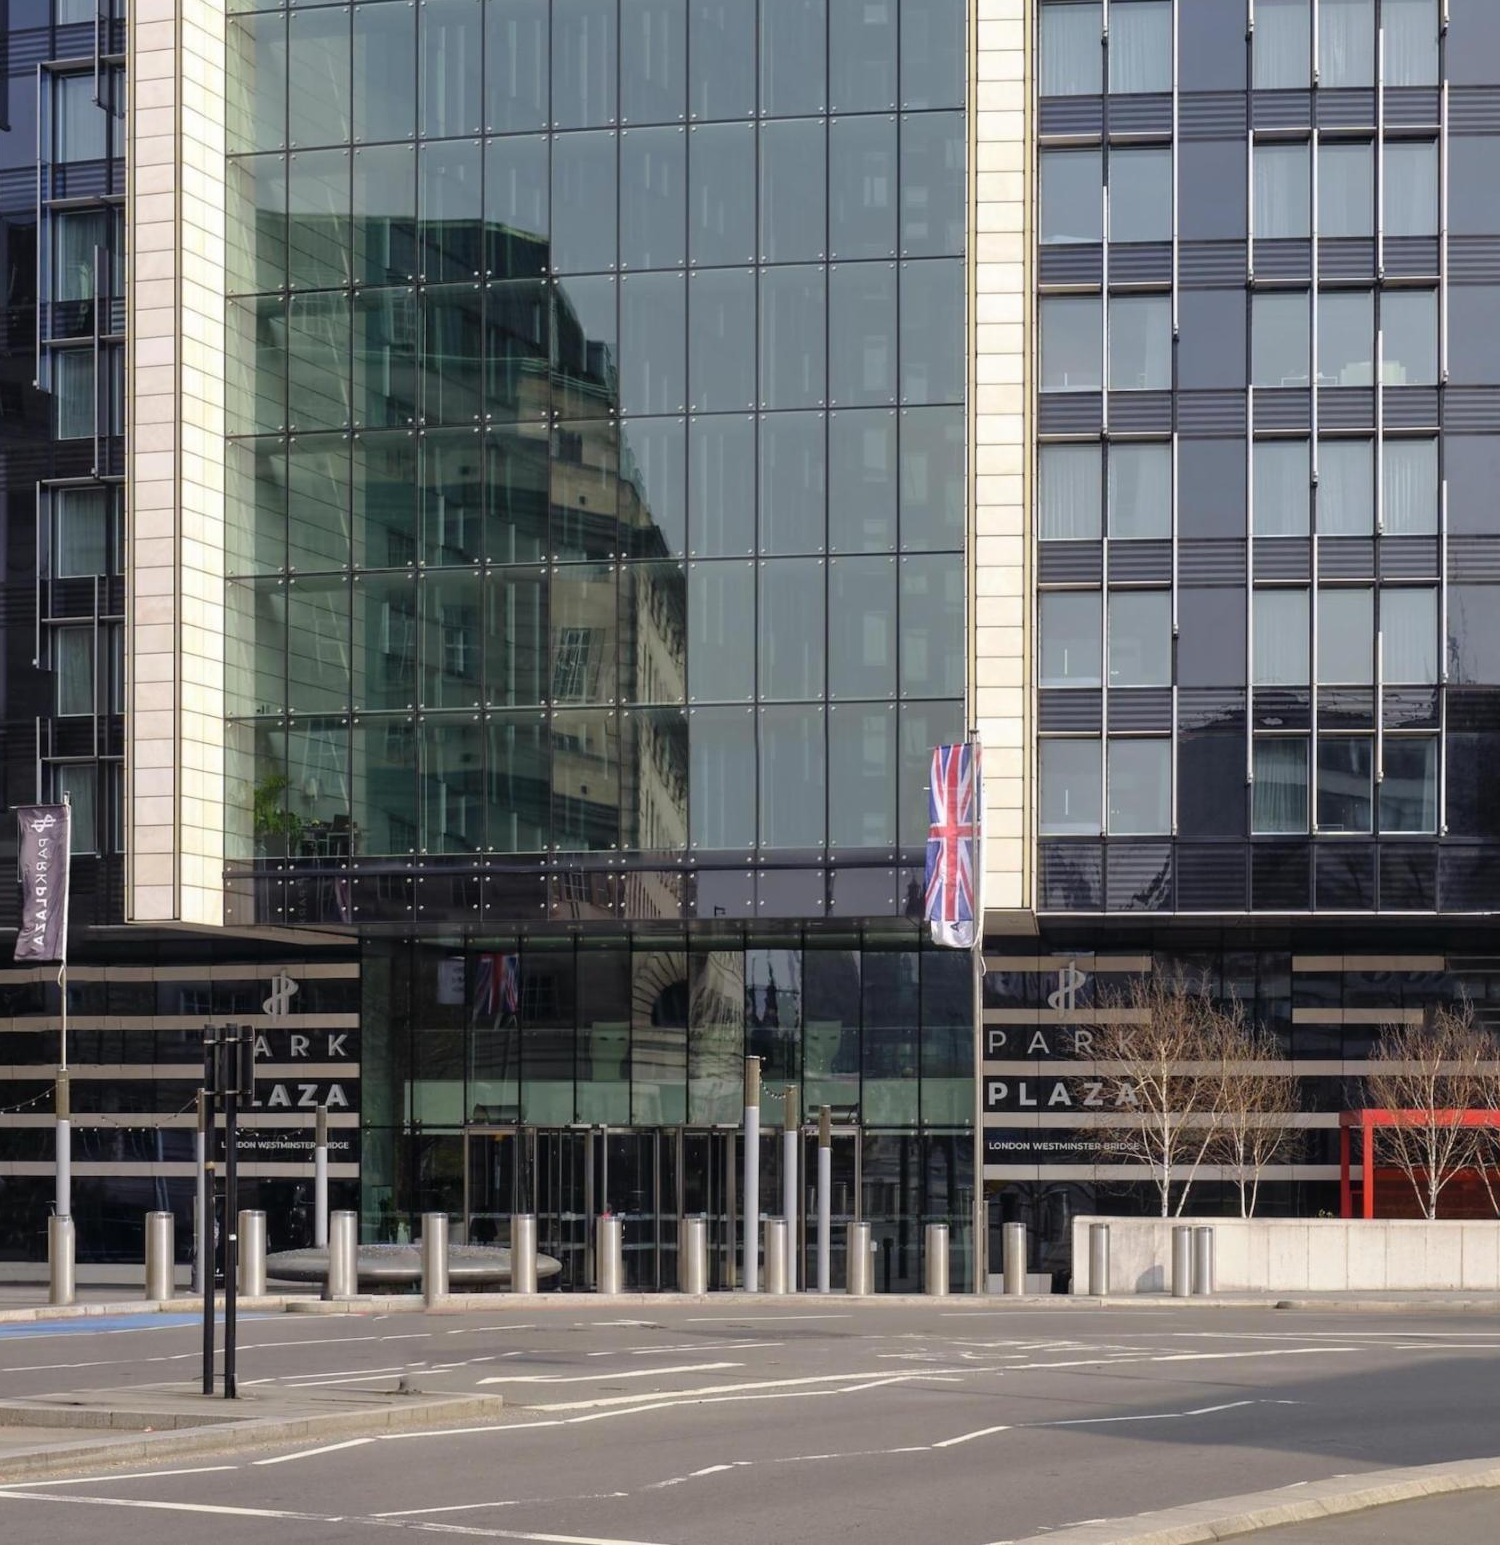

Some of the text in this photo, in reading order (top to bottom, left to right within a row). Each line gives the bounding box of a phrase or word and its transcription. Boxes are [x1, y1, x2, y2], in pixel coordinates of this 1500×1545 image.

[253, 1034, 349, 1056] ARK
[988, 1030, 1137, 1054] PARK
[988, 1082, 1139, 1106] PLAZA
[989, 1142, 1140, 1150] LONDON WESTMINSTER BRIDGE
